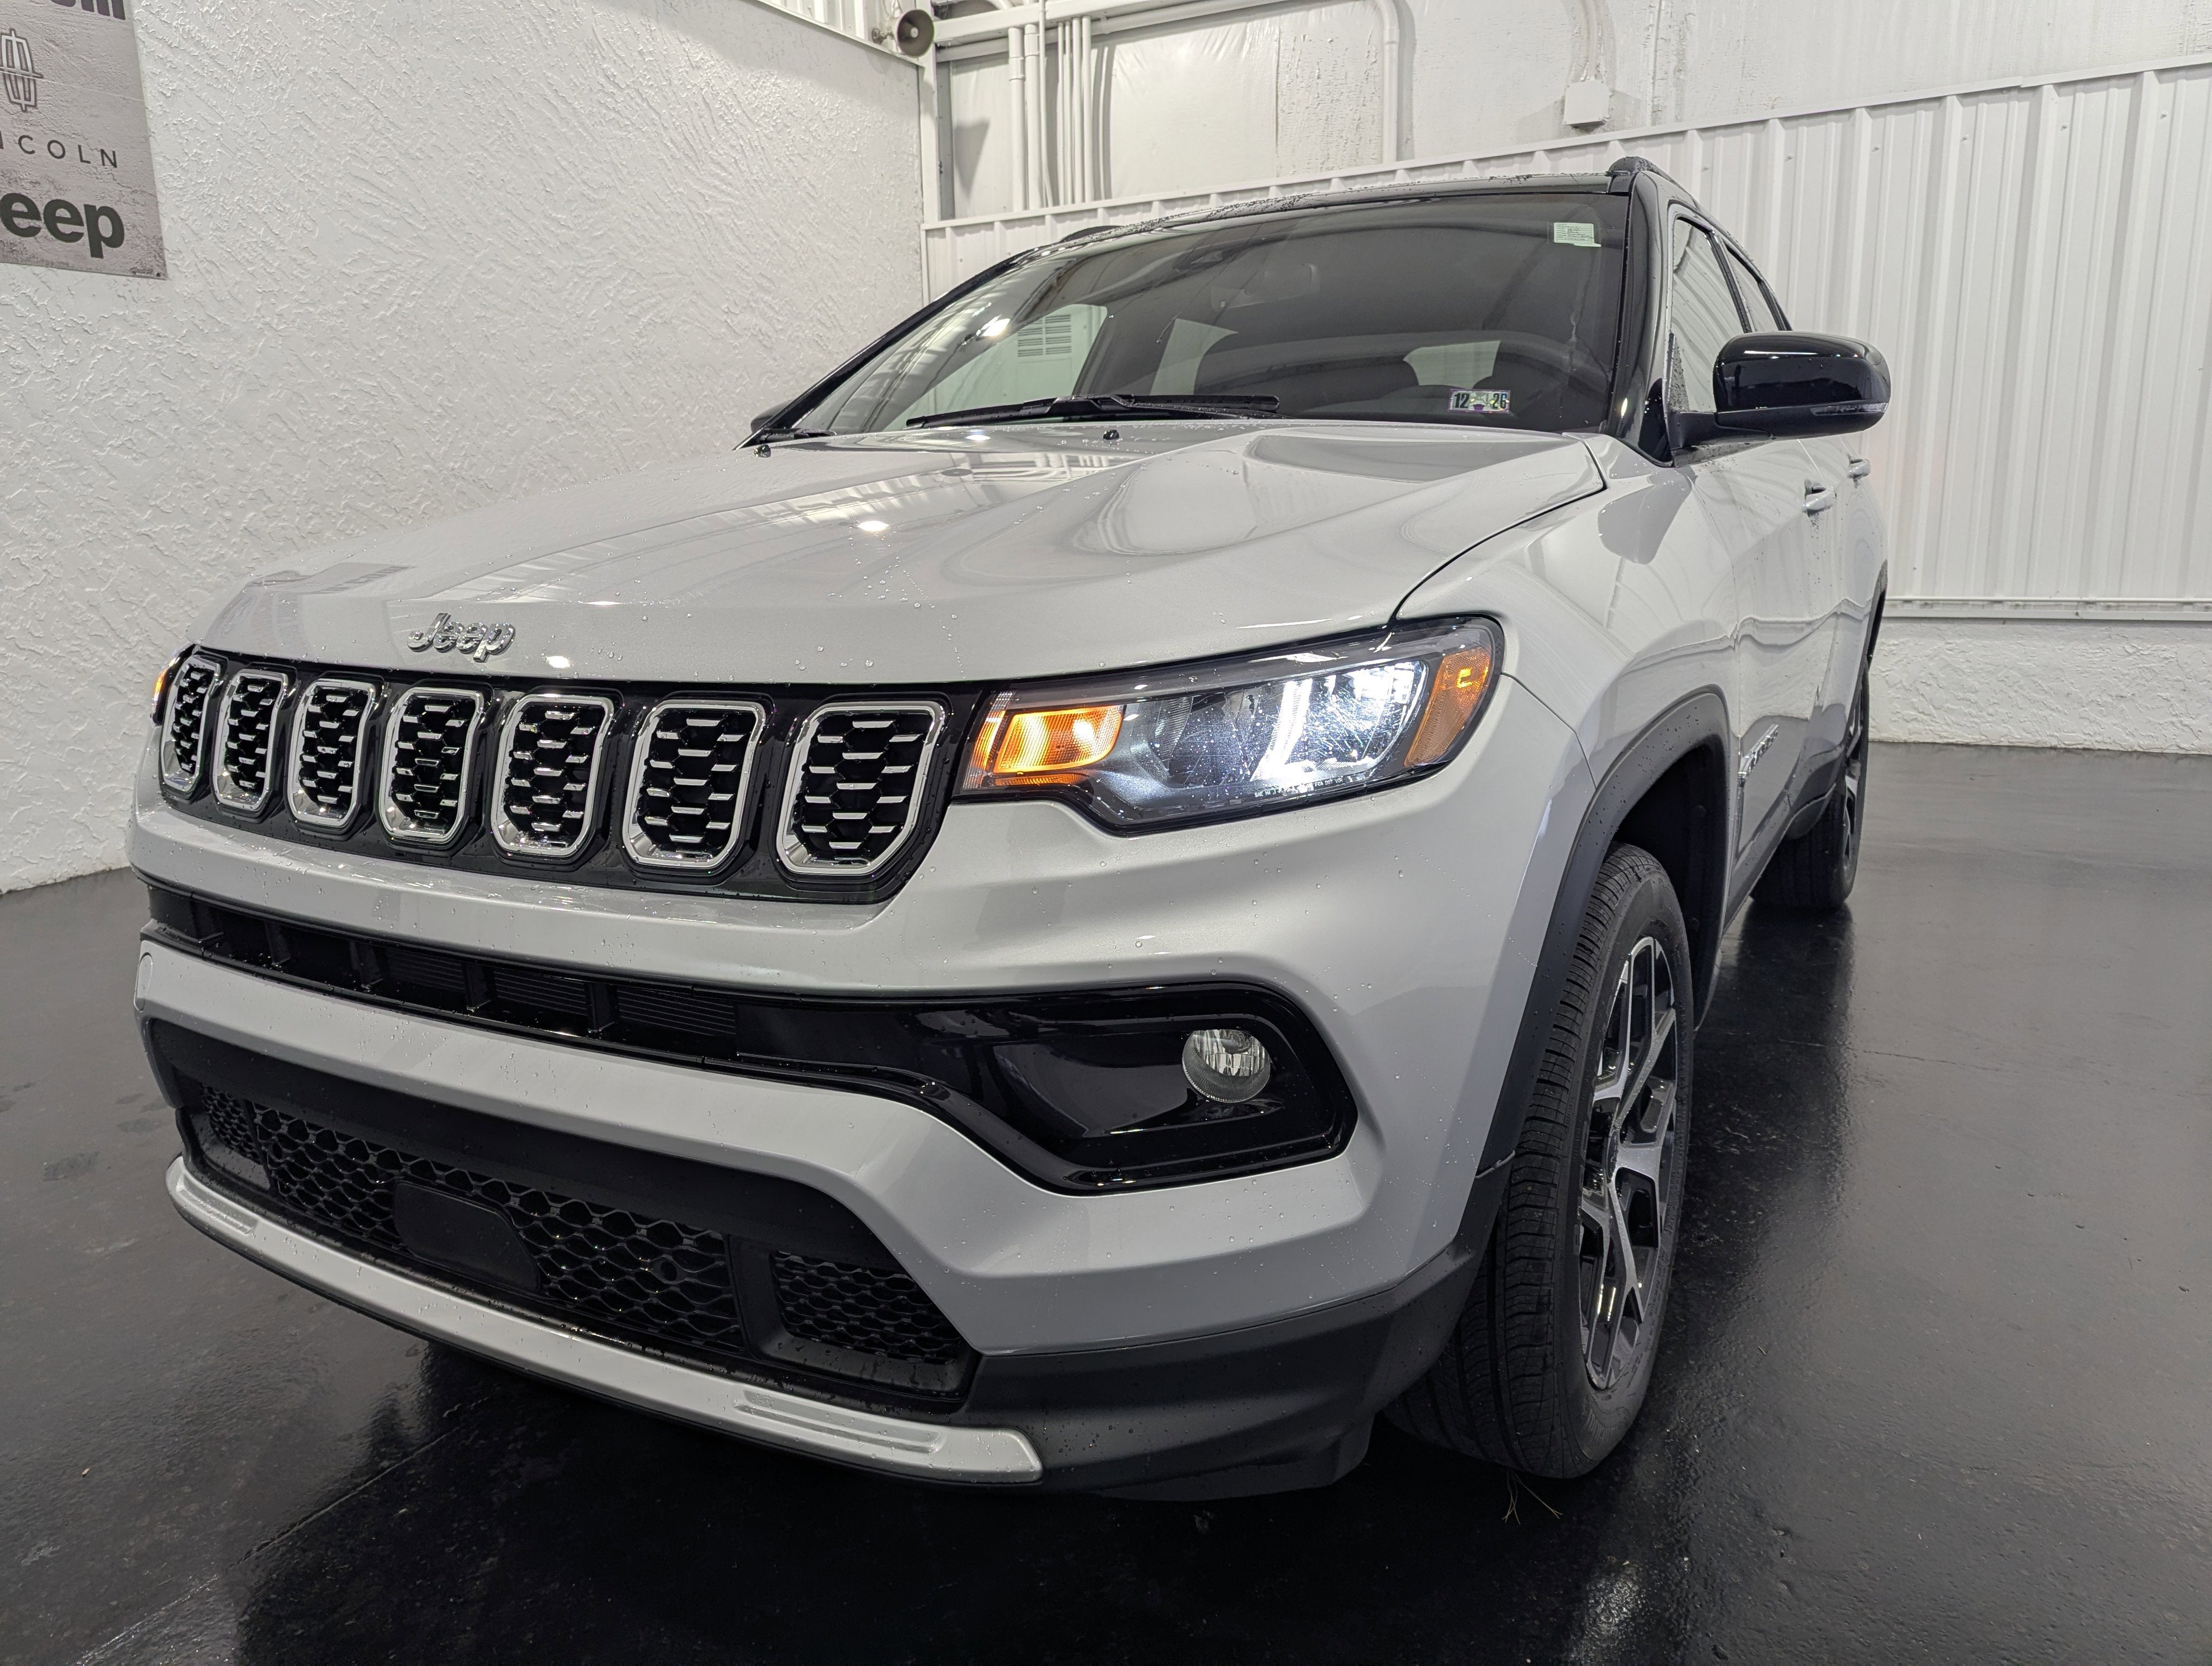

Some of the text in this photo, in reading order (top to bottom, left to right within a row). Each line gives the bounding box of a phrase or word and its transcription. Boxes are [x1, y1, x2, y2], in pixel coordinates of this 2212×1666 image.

[1454, 393, 1507, 409] 12 26
[407, 612, 516, 663] Jeep
